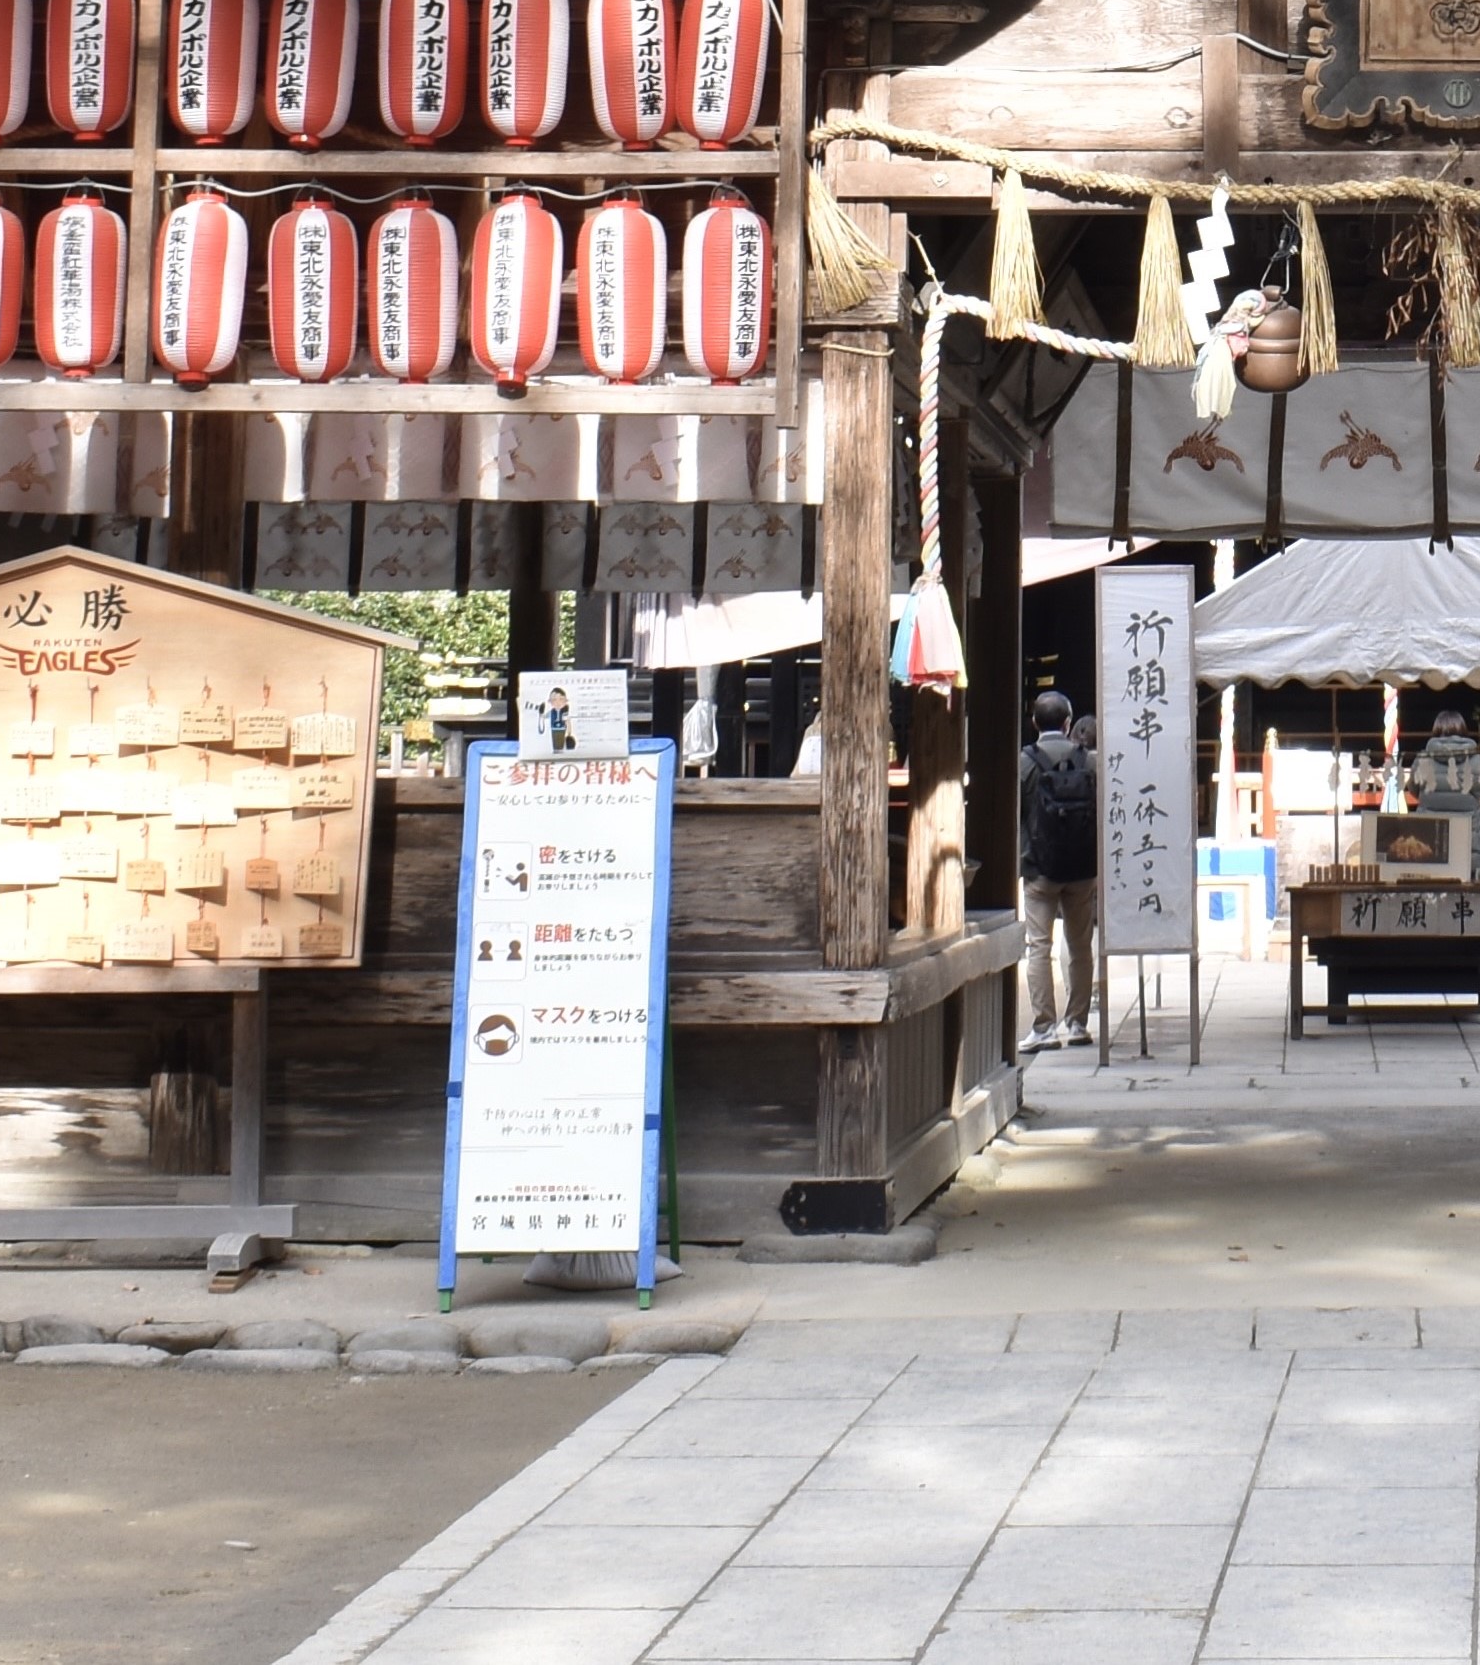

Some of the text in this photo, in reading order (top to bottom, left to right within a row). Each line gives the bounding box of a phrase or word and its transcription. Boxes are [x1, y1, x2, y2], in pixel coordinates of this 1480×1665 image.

[3, 583, 133, 633] 必勝
[33, 638, 103, 647] RAKUTEN
[1122, 610, 1174, 760] 祈願串
[483, 761, 658, 786] ご参拝の皆様へ
[538, 845, 617, 864] 密をさける
[1351, 893, 1475, 934] 祈願串
[534, 923, 634, 943] 距離をたもつ
[531, 1006, 648, 1024] マスクをつける
[472, 1213, 627, 1231] 宮城県神社庁
